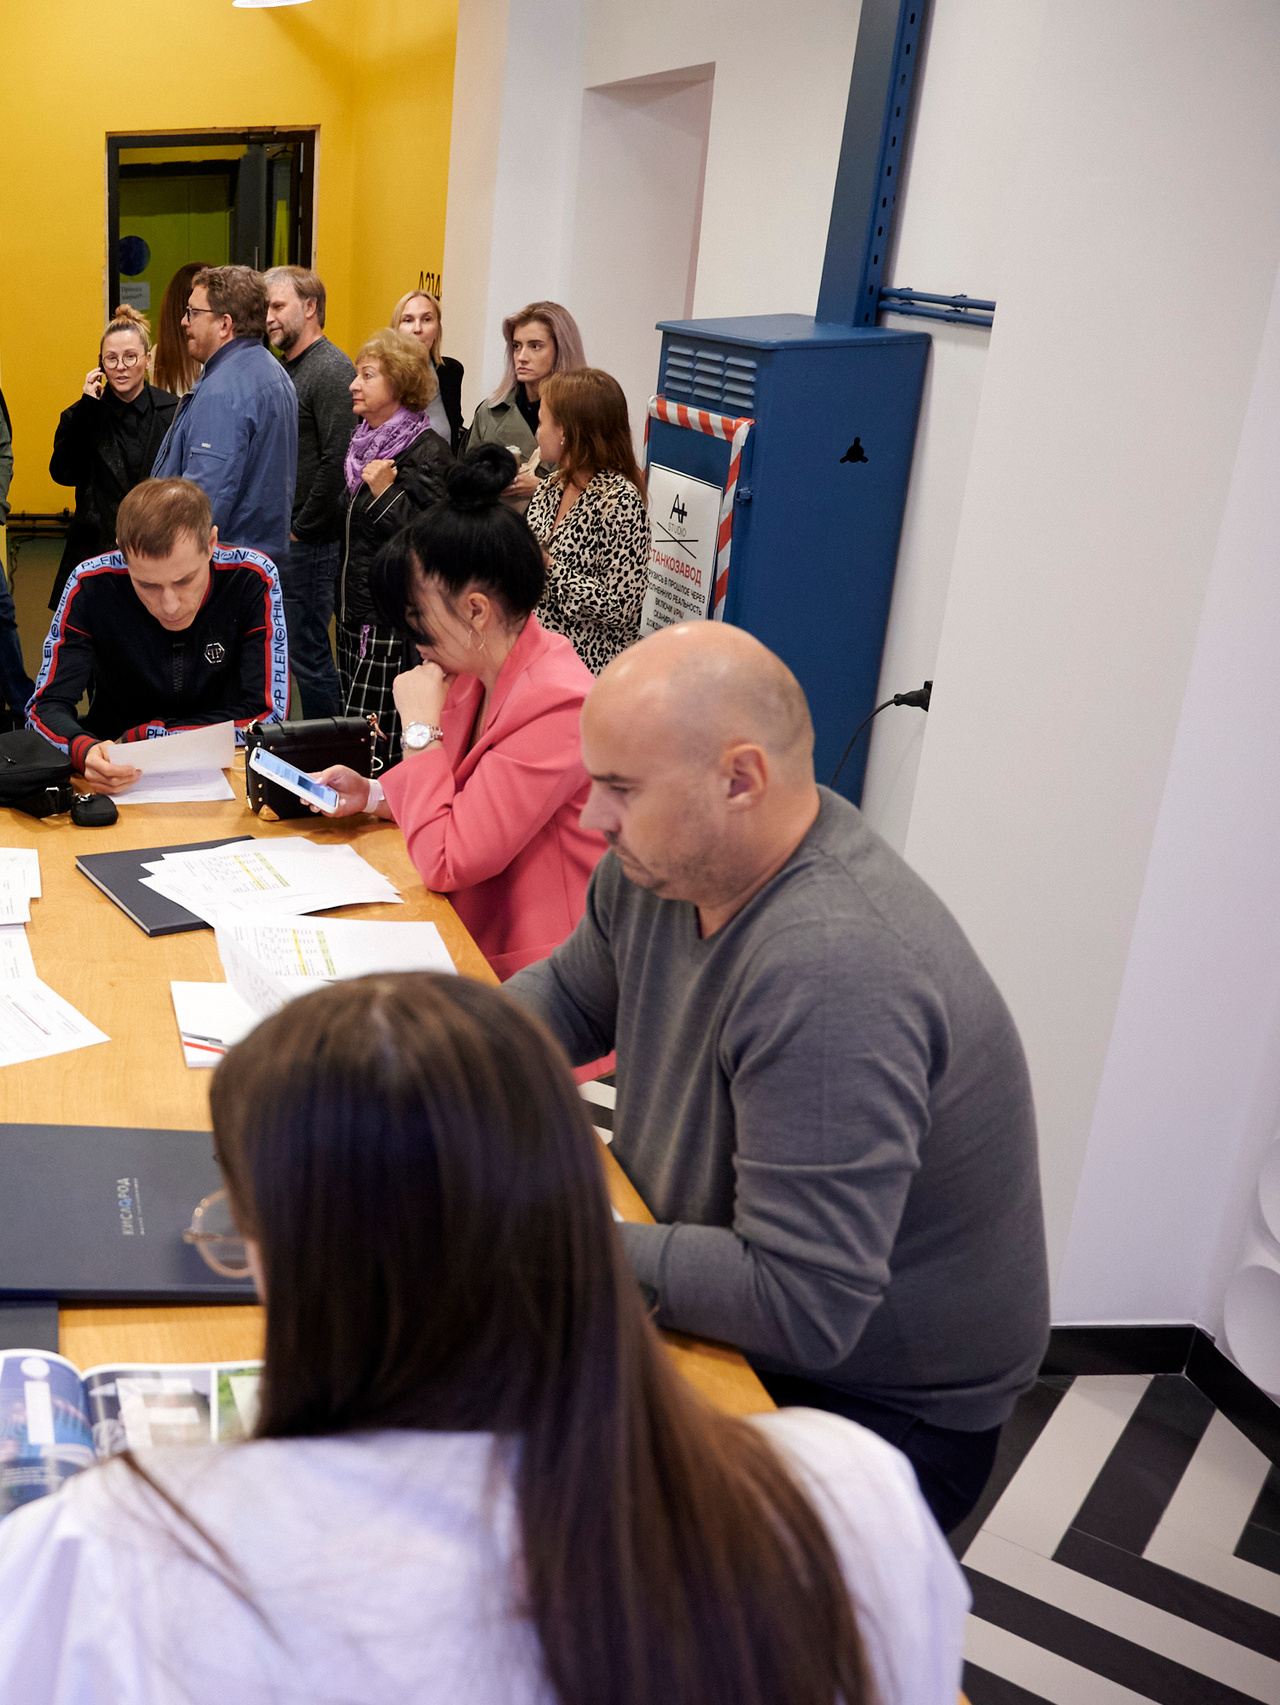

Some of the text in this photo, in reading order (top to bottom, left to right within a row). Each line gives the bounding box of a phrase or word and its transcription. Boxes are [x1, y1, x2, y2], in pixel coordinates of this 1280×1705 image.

[667, 521, 687, 538] STUDIO
[234, 549, 276, 574] PLEIN
[53, 554, 123, 624] PHILIPP PLEIN
[646, 568, 664, 584] РУЗИСЬ
[667, 578, 690, 597] ПРОШЛОЕ
[690, 589, 706, 604] ЧЕРЕЗ
[649, 582, 703, 616] ОЛНЕННУЮ РЕАЛЬНОСТЬ
[655, 597, 673, 613] ВКЛЮЧИ
[39, 636, 55, 677] PLEIN
[273, 641, 286, 684] PLEIN
